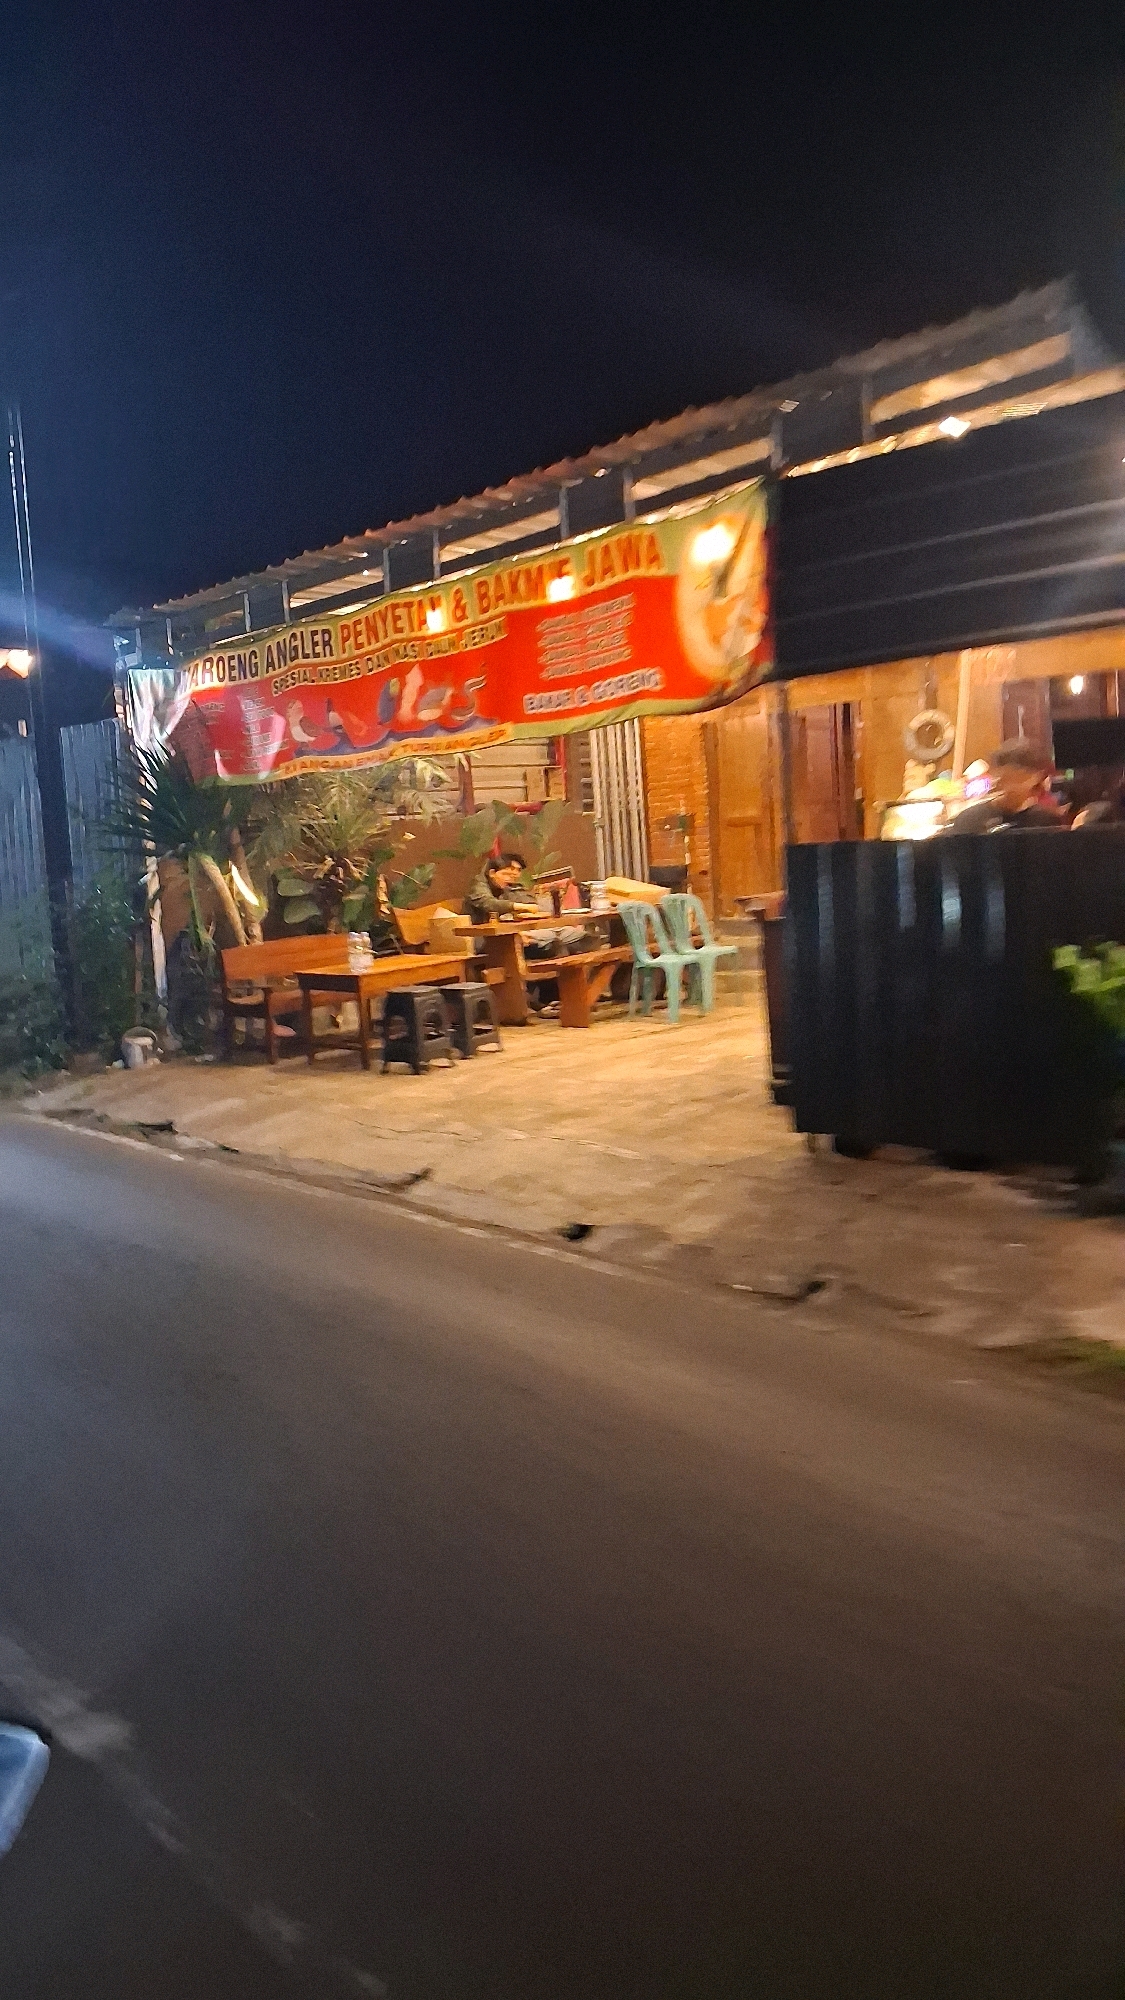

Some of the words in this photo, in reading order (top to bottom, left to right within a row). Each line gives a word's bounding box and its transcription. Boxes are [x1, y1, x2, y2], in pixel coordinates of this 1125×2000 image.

[265, 628, 334, 674] ANGLER
[452, 586, 469, 624] &
[583, 532, 662, 588] JAWA
